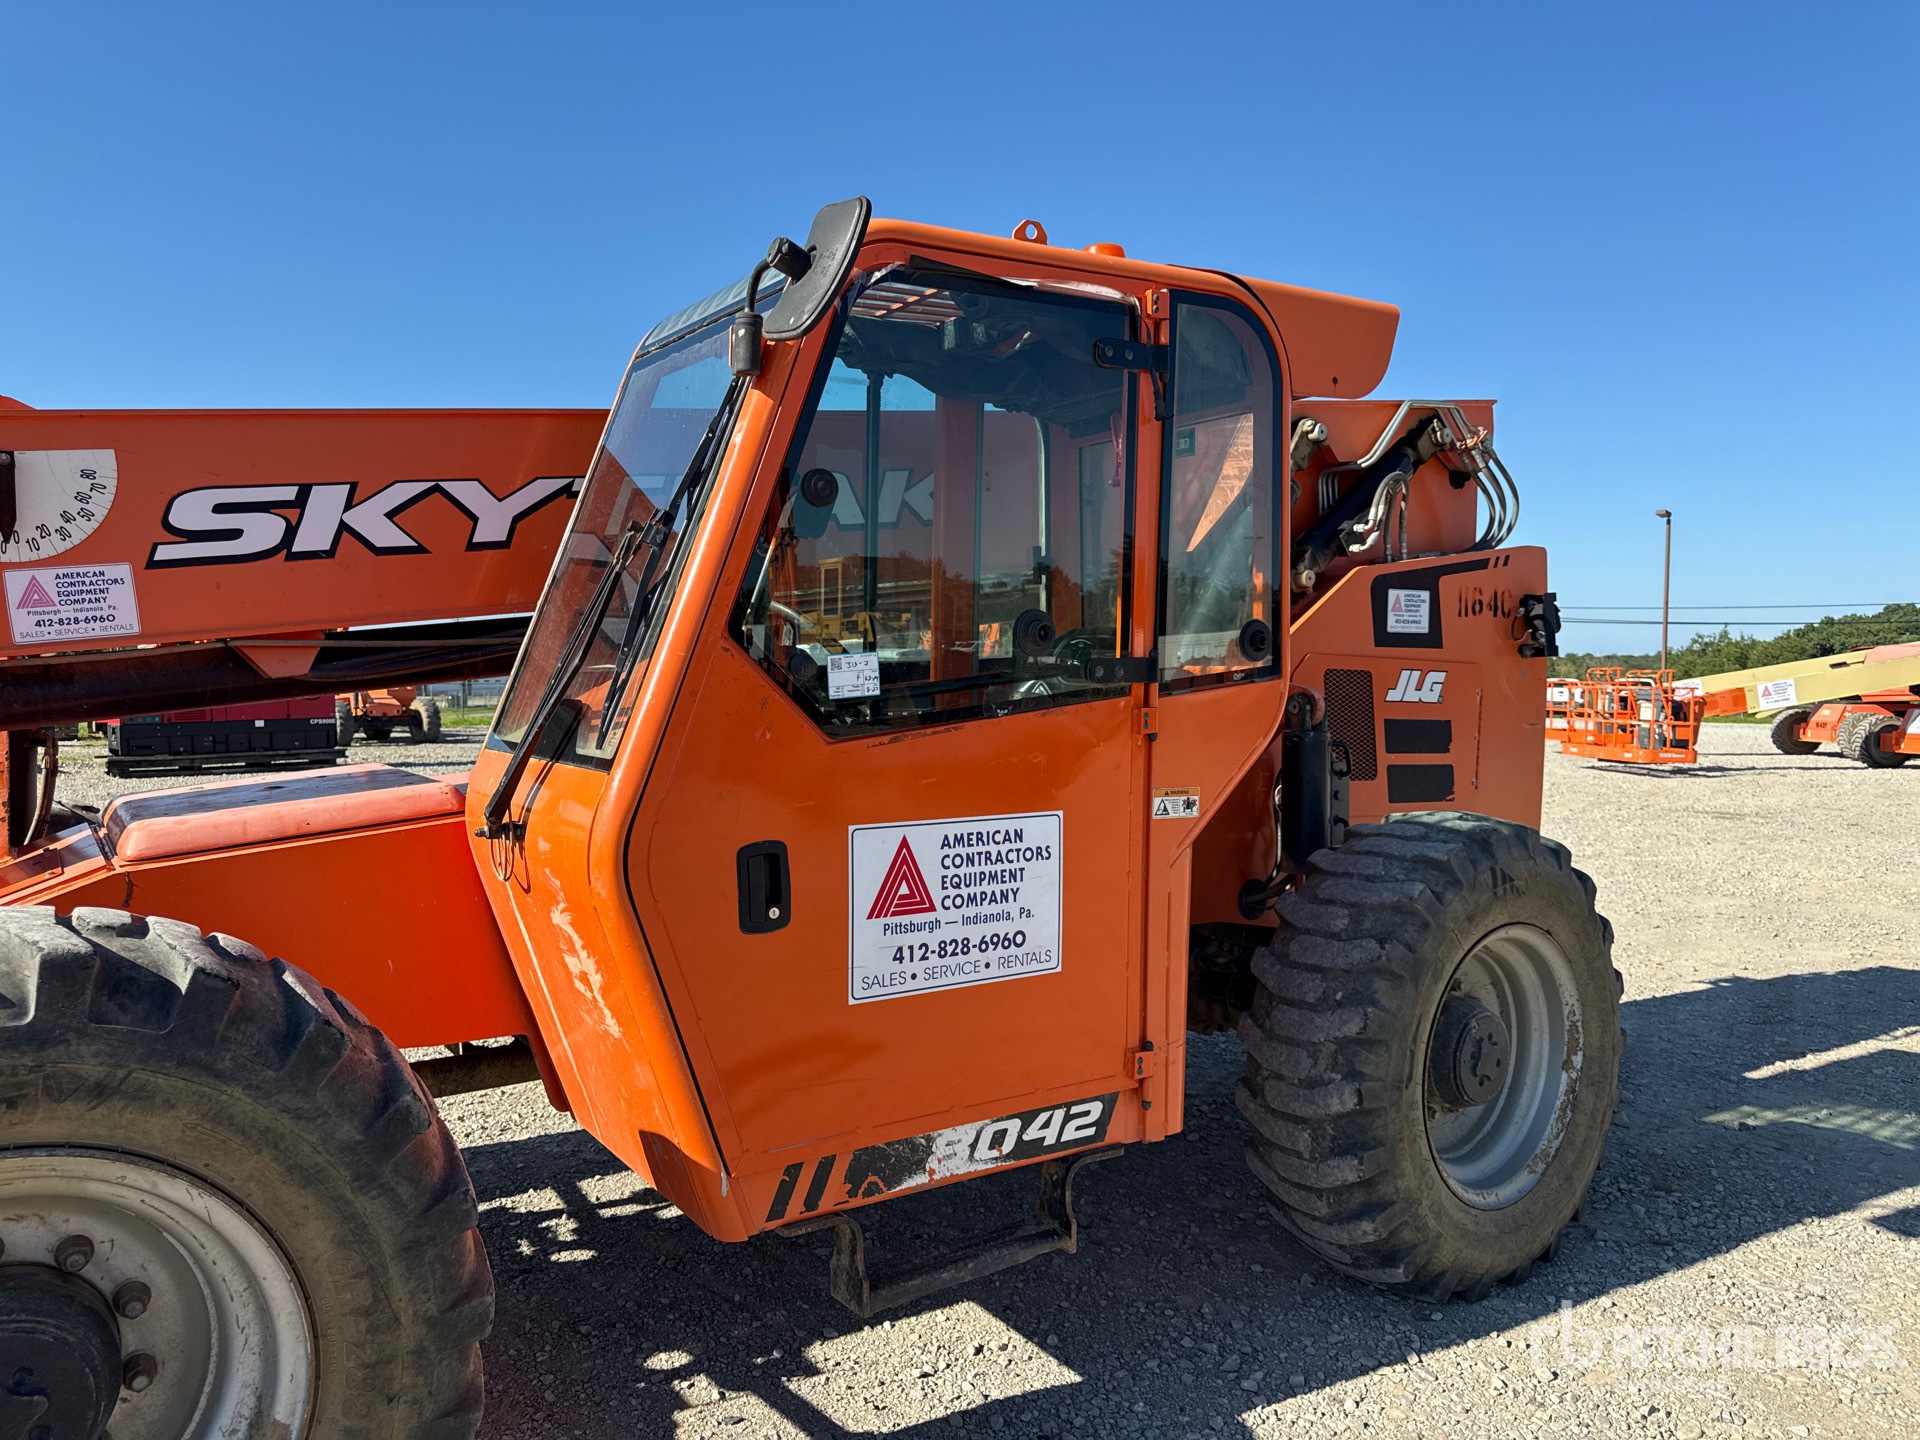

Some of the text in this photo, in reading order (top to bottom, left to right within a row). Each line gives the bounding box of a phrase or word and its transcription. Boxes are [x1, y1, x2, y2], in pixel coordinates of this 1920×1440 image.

[80, 469, 97, 480] 80
[89, 482, 107, 495] 70
[74, 491, 92, 504] 60
[60, 510, 76, 525] 40
[77, 507, 95, 522] 50
[13, 530, 20, 544] 0
[36, 523, 51, 539] 20
[55, 526, 72, 541] 30
[26, 537, 40, 552] 10
[55, 570, 105, 580] AMERICAN
[56, 578, 125, 589] CONTRACTORS
[57, 587, 110, 598] EQUIPMENT
[58, 596, 108, 606] COMPANY
[27, 608, 62, 617] Pittsburgh
[35, 614, 116, 628] 412-828-6960
[19, 623, 134, 639] SALES SERVICE RENTALS
[1385, 669, 1447, 704] JLG
[940, 828, 1024, 850] AMERICAN
[940, 845, 1052, 870] CONTRACTORS
[941, 867, 1026, 891] EQUIPMENT
[941, 887, 1020, 911] COMPANY
[882, 906, 1035, 937] Pittsburgh Indianola, Pa.
[892, 930, 1027, 965] 412-828-6960
[861, 949, 1052, 991] SALES SERVICE RENTALS
[927, 1100, 1104, 1171] 8042
